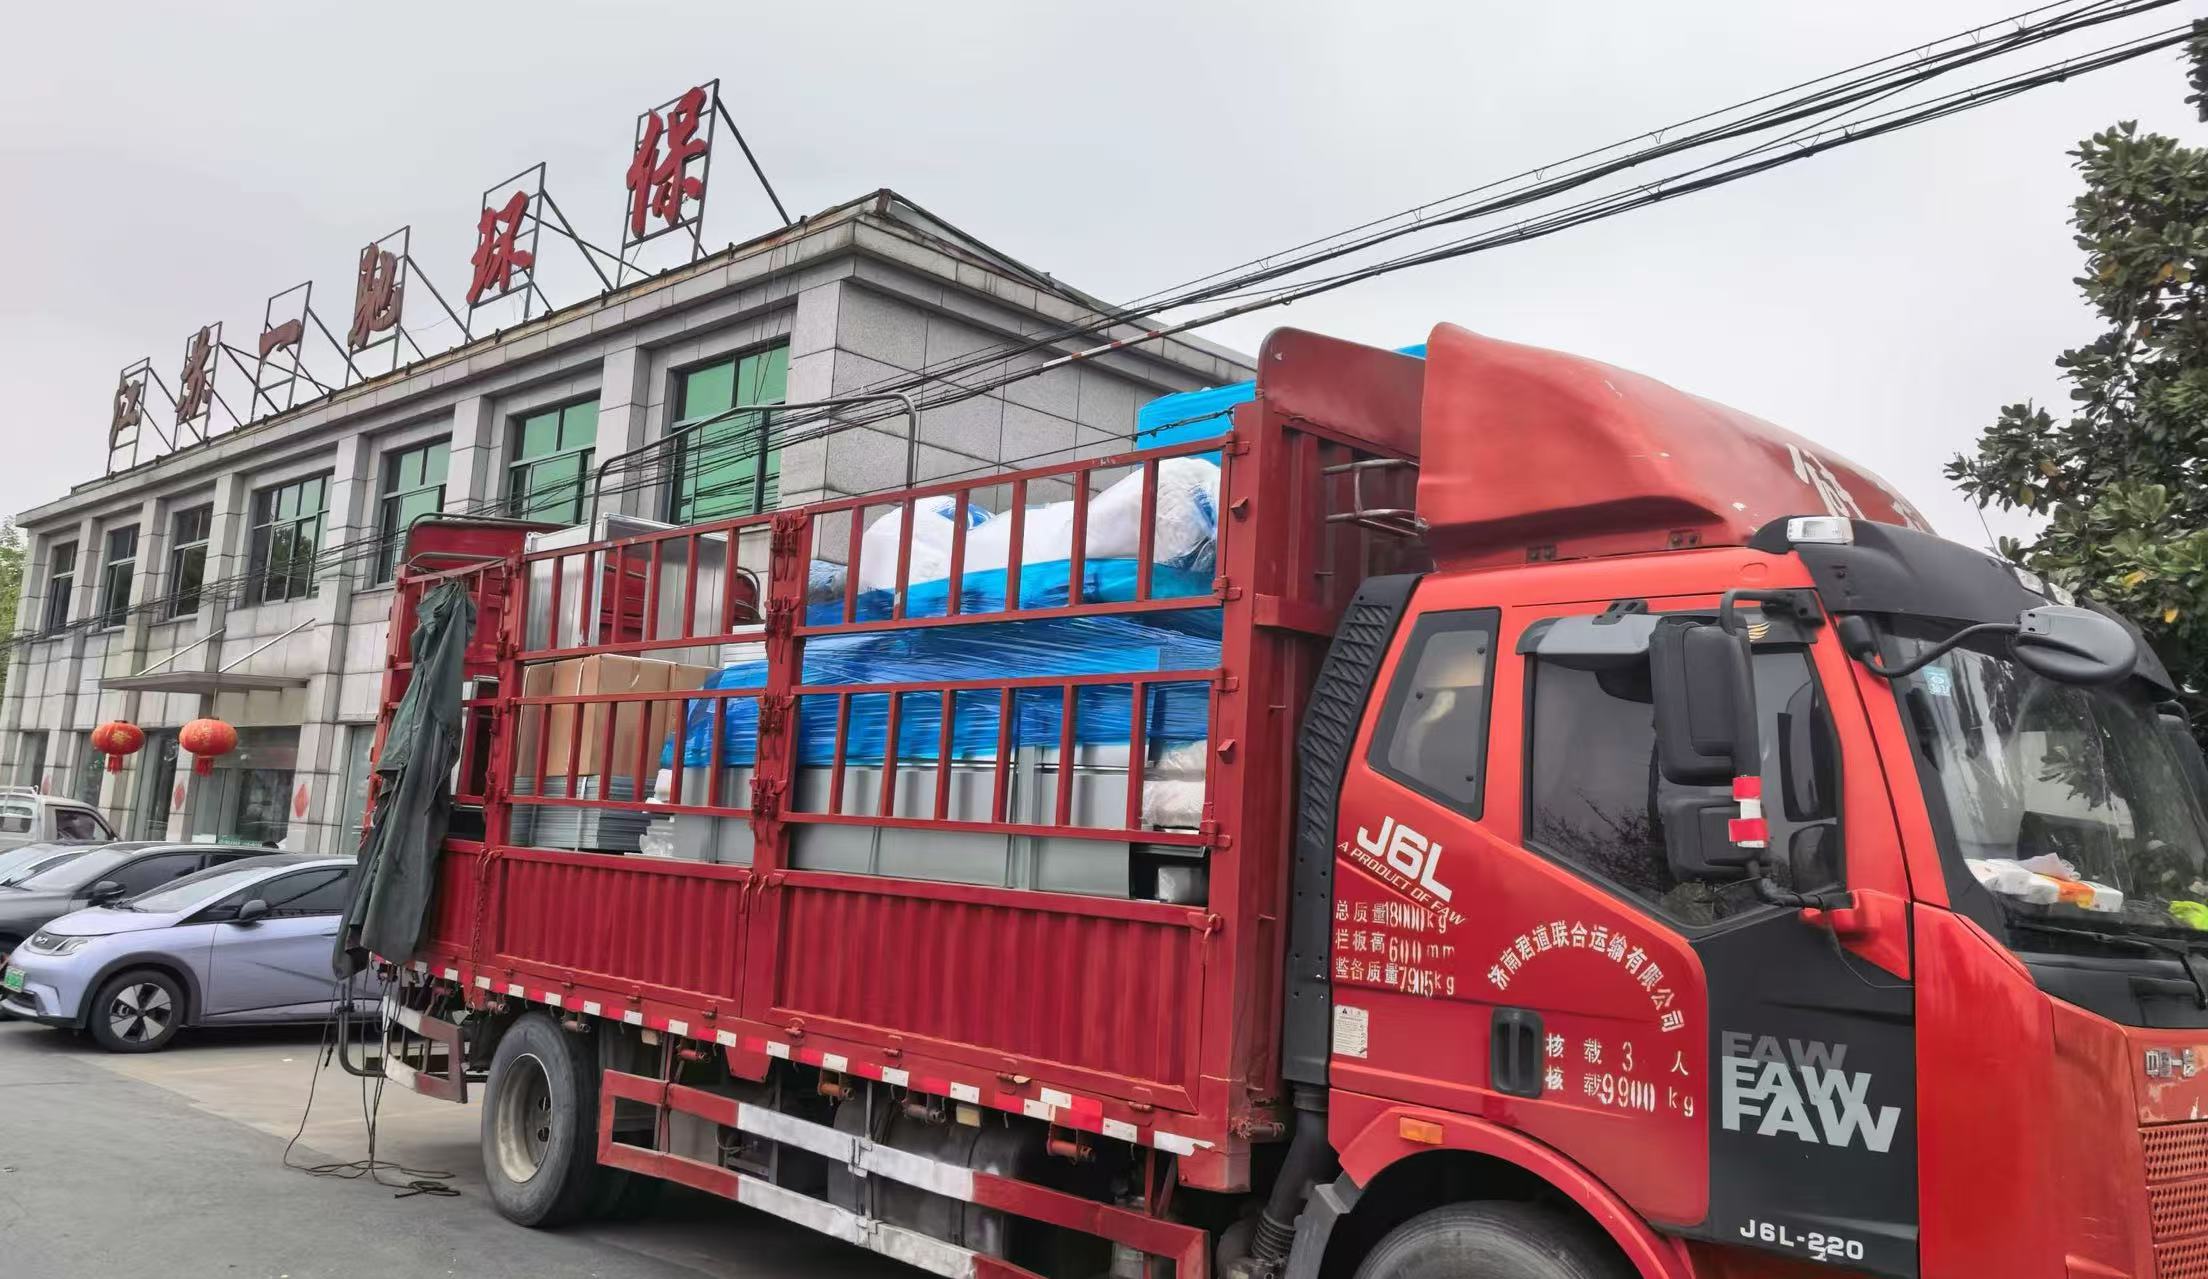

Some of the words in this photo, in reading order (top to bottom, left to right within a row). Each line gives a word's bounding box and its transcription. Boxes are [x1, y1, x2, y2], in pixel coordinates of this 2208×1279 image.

[1338, 841, 1349, 853] A
[1350, 848, 1411, 890] PRODUCT
[1410, 887, 1432, 902] OF
[1430, 900, 1466, 925] FAW
[1357, 815, 1453, 903] J6L
[1722, 1031, 1848, 1073] FAW
[1722, 1055, 1872, 1106] FAW
[1722, 1086, 1901, 1153] FAW
[1740, 1219, 1864, 1261] J6L-220
